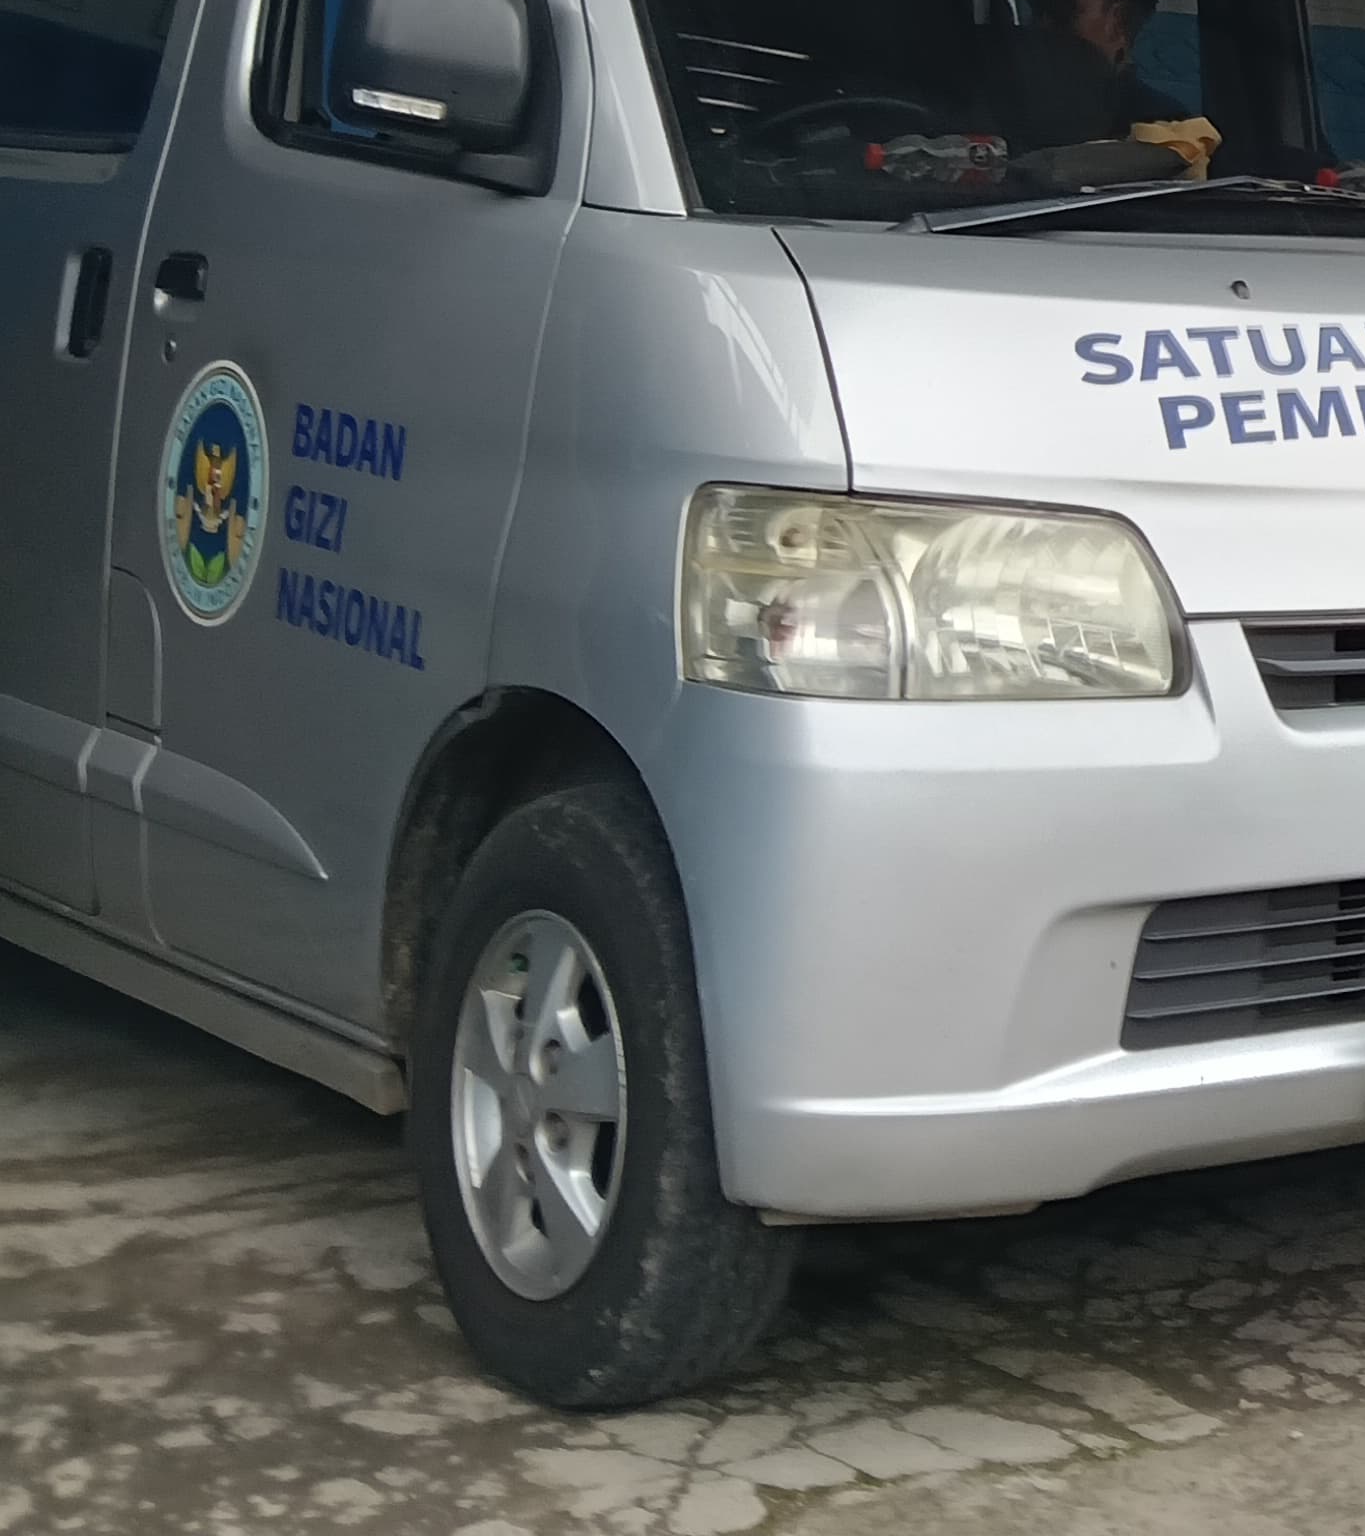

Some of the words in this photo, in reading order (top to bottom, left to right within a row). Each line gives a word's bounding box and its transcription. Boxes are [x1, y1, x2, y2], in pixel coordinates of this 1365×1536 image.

[291, 402, 408, 482] BADAN
[284, 484, 348, 554] GIZI
[276, 567, 425, 671] NASIONAL
